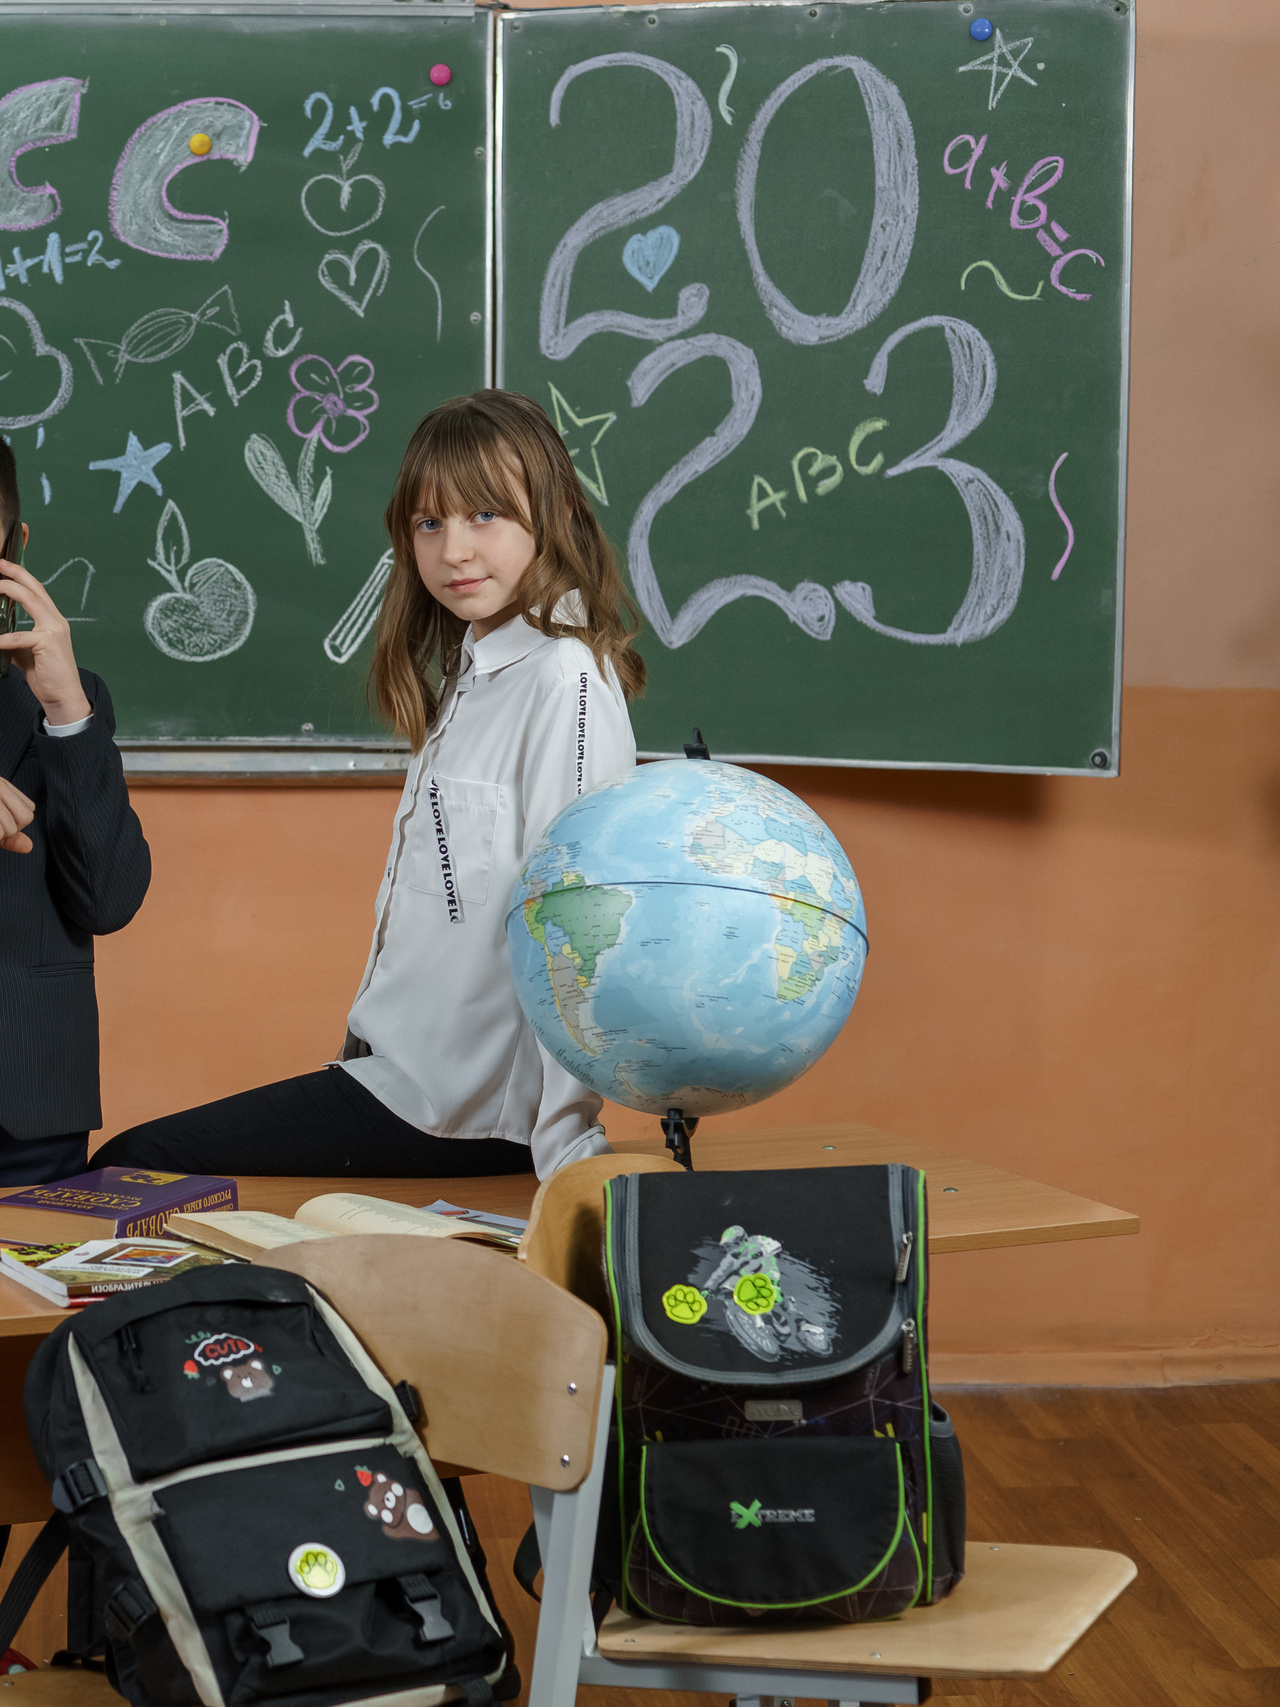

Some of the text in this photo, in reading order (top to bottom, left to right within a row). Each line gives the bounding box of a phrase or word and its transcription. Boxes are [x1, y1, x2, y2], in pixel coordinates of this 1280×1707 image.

[539, 51, 919, 361] 20
[627, 315, 1026, 650] 23
[431, 801, 445, 836] LOVE
[437, 837, 451, 871] LOVE
[443, 872, 457, 907] LOVE
[33, 1189, 141, 1208] СЛОВАРЬ
[203, 1189, 232, 1208] РУССКОГО
